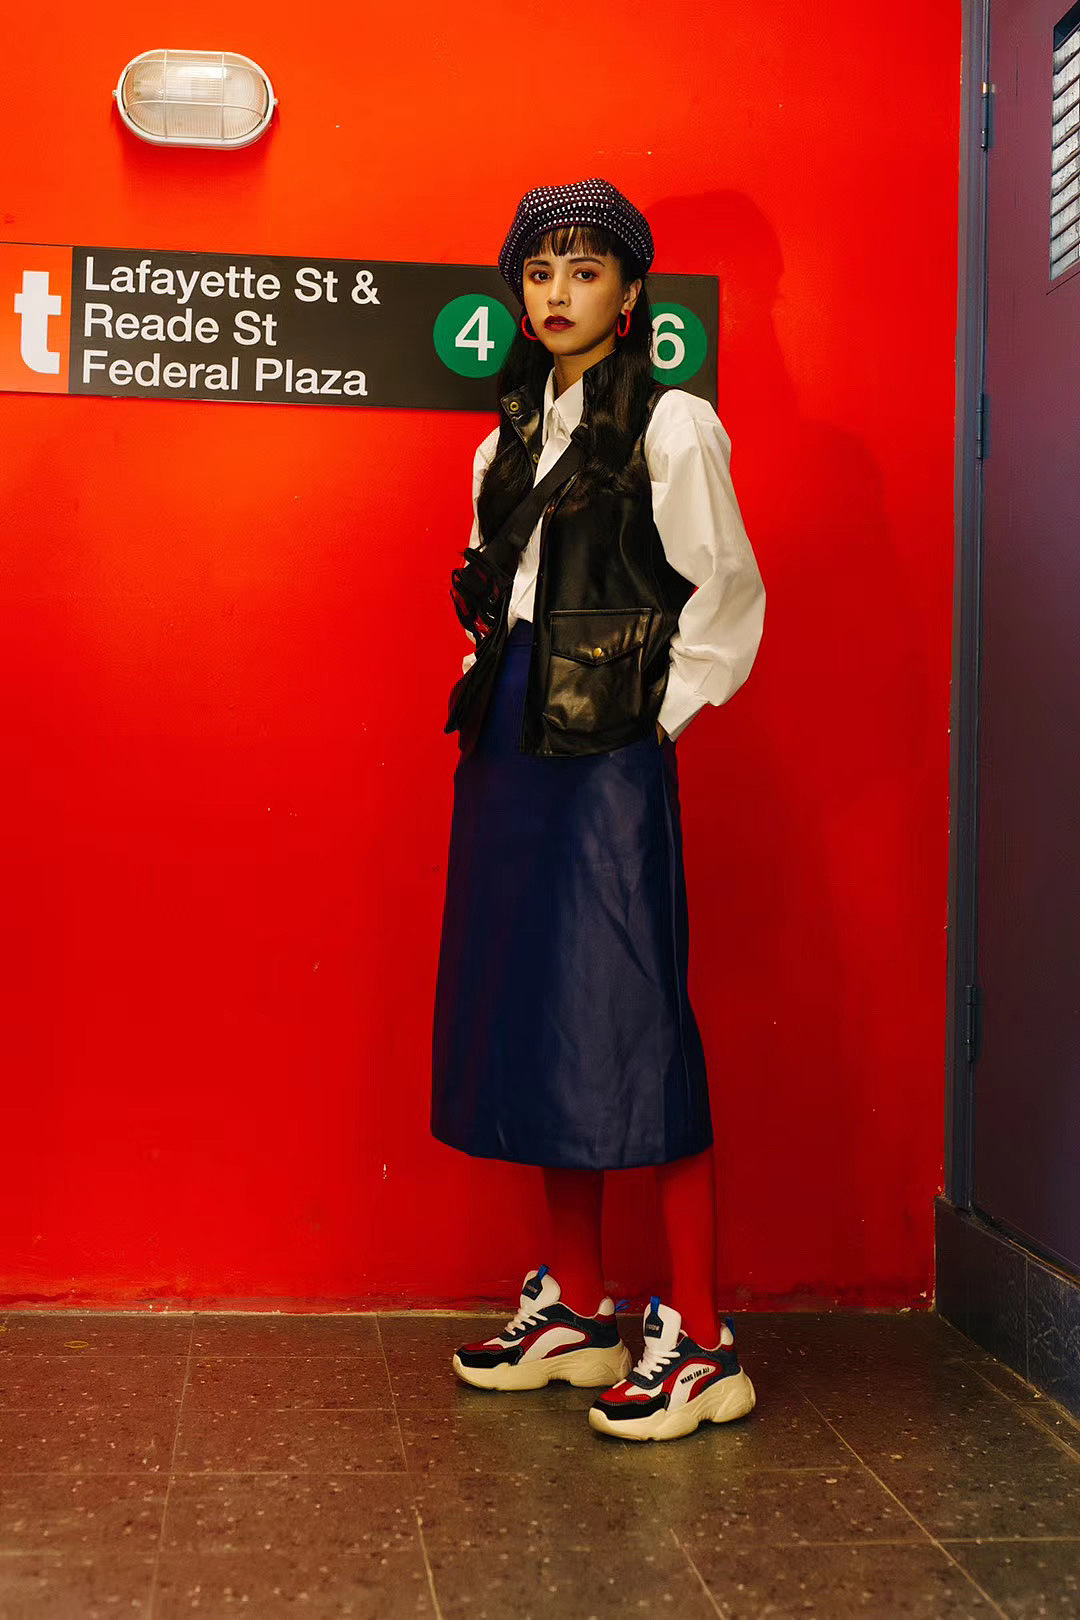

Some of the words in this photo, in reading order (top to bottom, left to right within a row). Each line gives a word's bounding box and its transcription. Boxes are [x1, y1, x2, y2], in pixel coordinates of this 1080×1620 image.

[85, 256, 281, 304] Lafayette
[294, 267, 339, 303] St
[351, 270, 381, 305] &
[84, 302, 220, 344] Reade
[232, 310, 278, 347] St
[455, 305, 495, 361] 4
[651, 312, 686, 370] 6
[82, 349, 239, 391] Federal
[255, 357, 368, 396] Plaza
